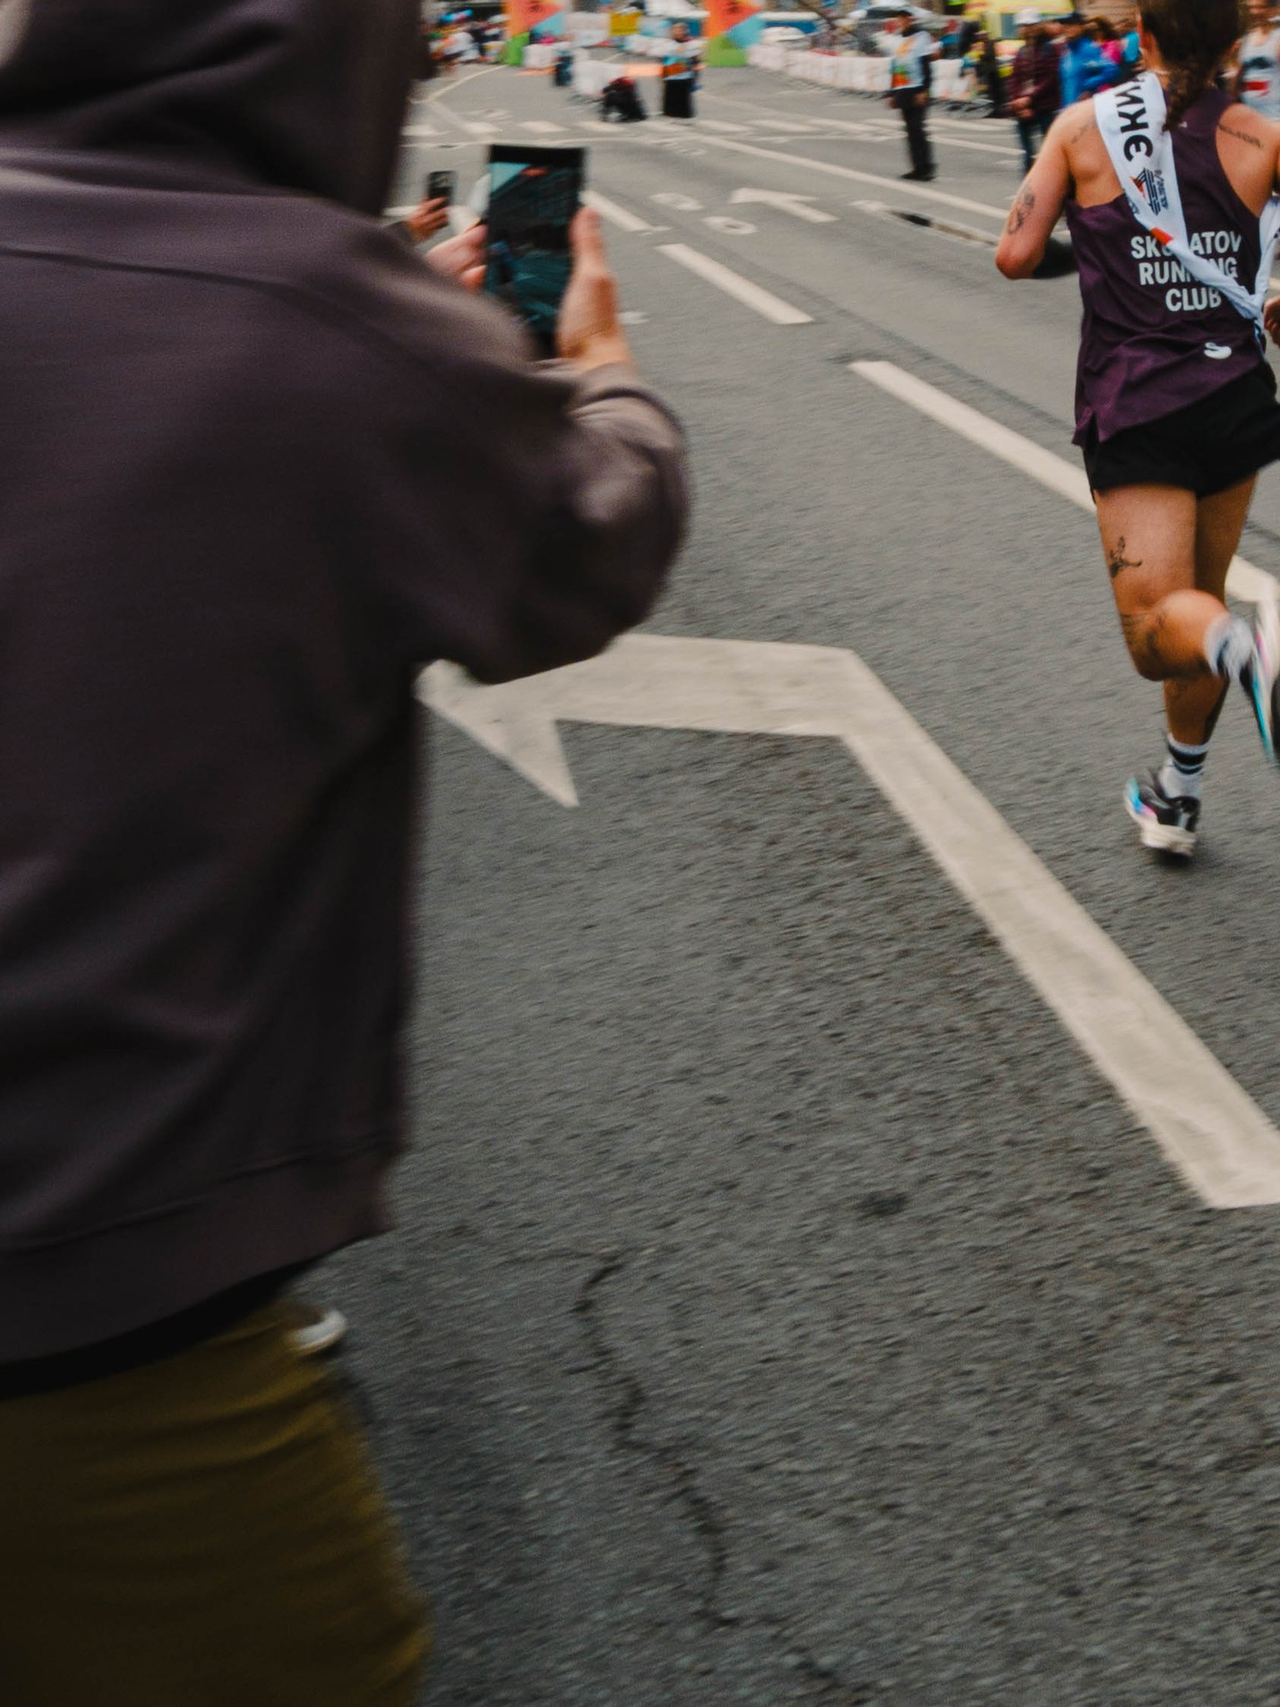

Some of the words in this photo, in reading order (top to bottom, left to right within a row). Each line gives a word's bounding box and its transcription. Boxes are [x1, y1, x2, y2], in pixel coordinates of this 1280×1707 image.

[1130, 230, 1242, 259] SKATOV
[1138, 257, 1239, 286] RUNNG
[1165, 287, 1222, 312] CLUB
